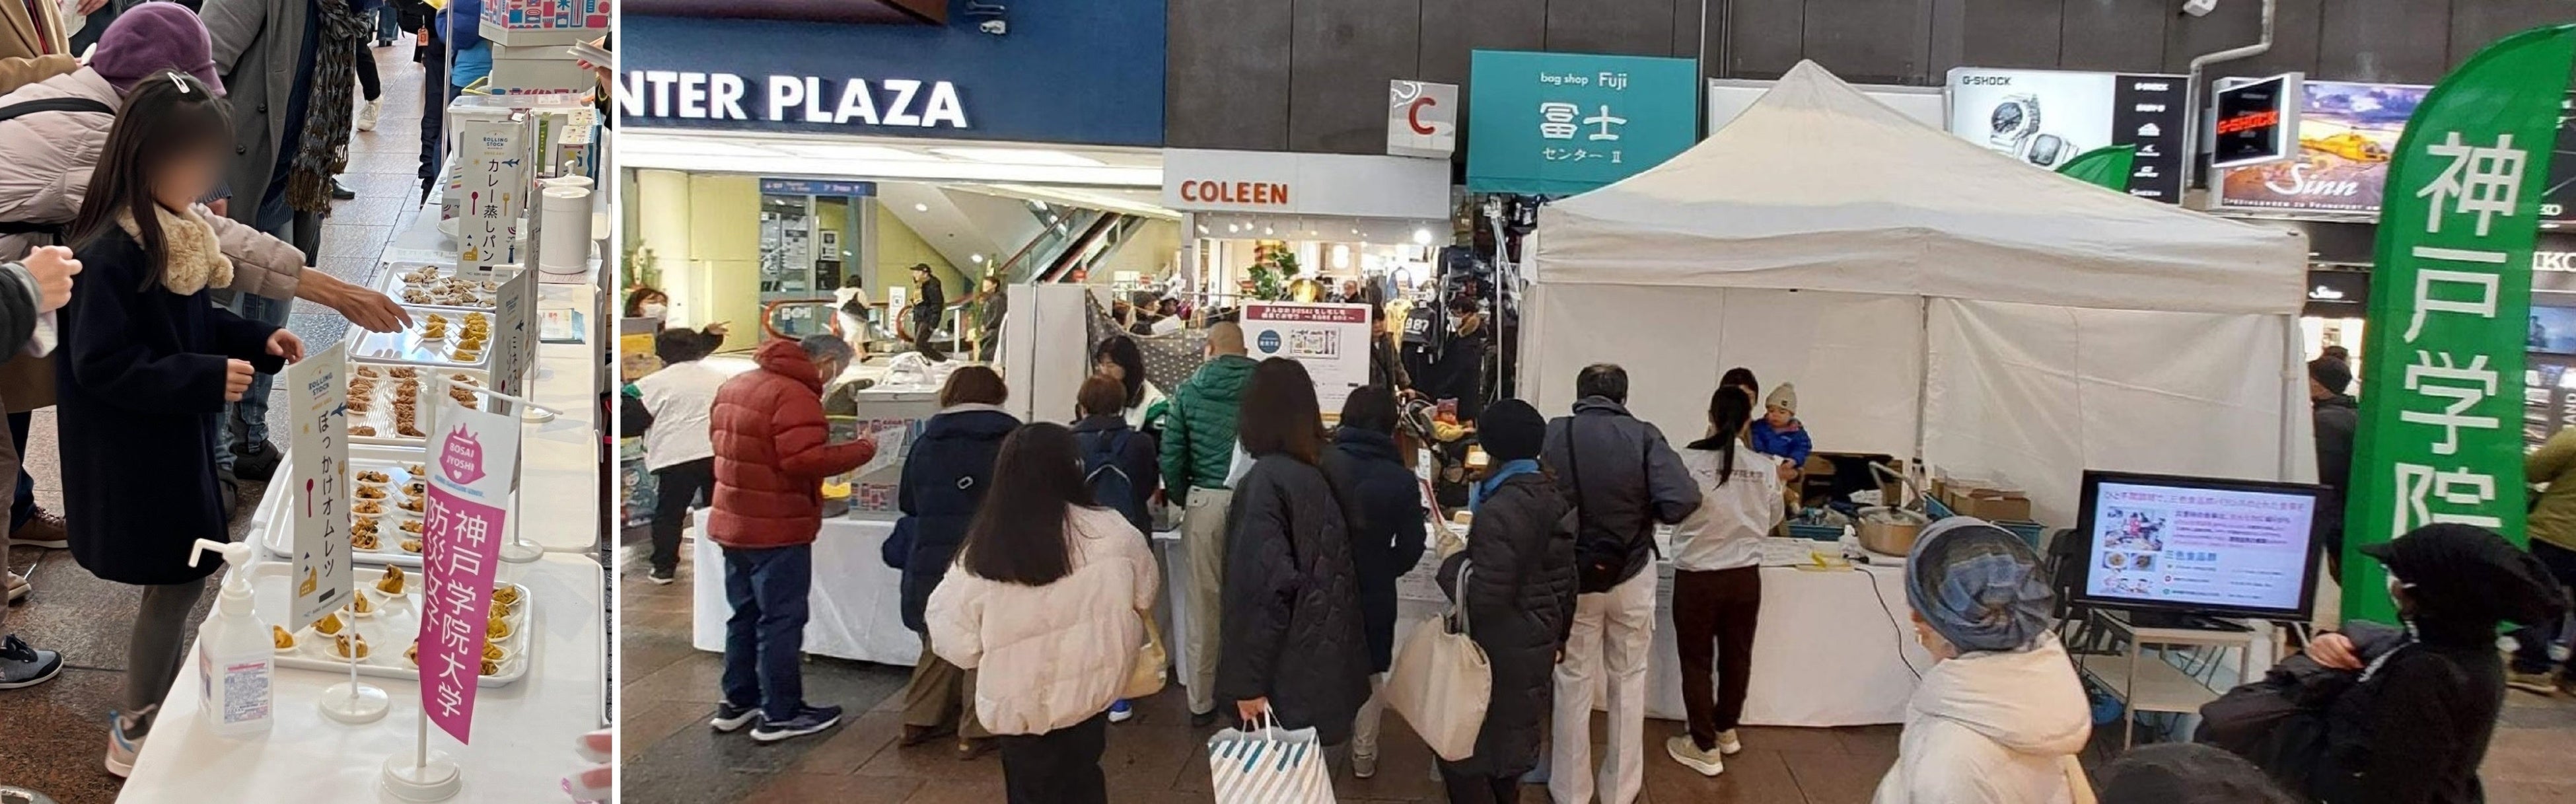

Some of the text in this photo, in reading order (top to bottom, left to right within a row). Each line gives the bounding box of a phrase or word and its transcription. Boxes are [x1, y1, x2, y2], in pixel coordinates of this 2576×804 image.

[1540, 71, 1628, 91] bag shop Fuji
[1962, 75, 2012, 85] G-SHOCK
[768, 75, 967, 128] PLAZA
[1408, 97, 1436, 135] C
[2217, 110, 2279, 135] G-SHOCK
[1543, 147, 1604, 161] センター
[1180, 180, 1288, 205] COLEEN
[2266, 163, 2359, 196] Sinn
[483, 159, 499, 262] カレー蒸しパン
[2392, 131, 2528, 540] 神戸学院
[449, 443, 475, 458] BOSAI
[318, 410, 334, 577] ぼっかけオムレツ
[426, 496, 450, 633] 防災女子
[437, 509, 488, 717] 神戸学院大学
